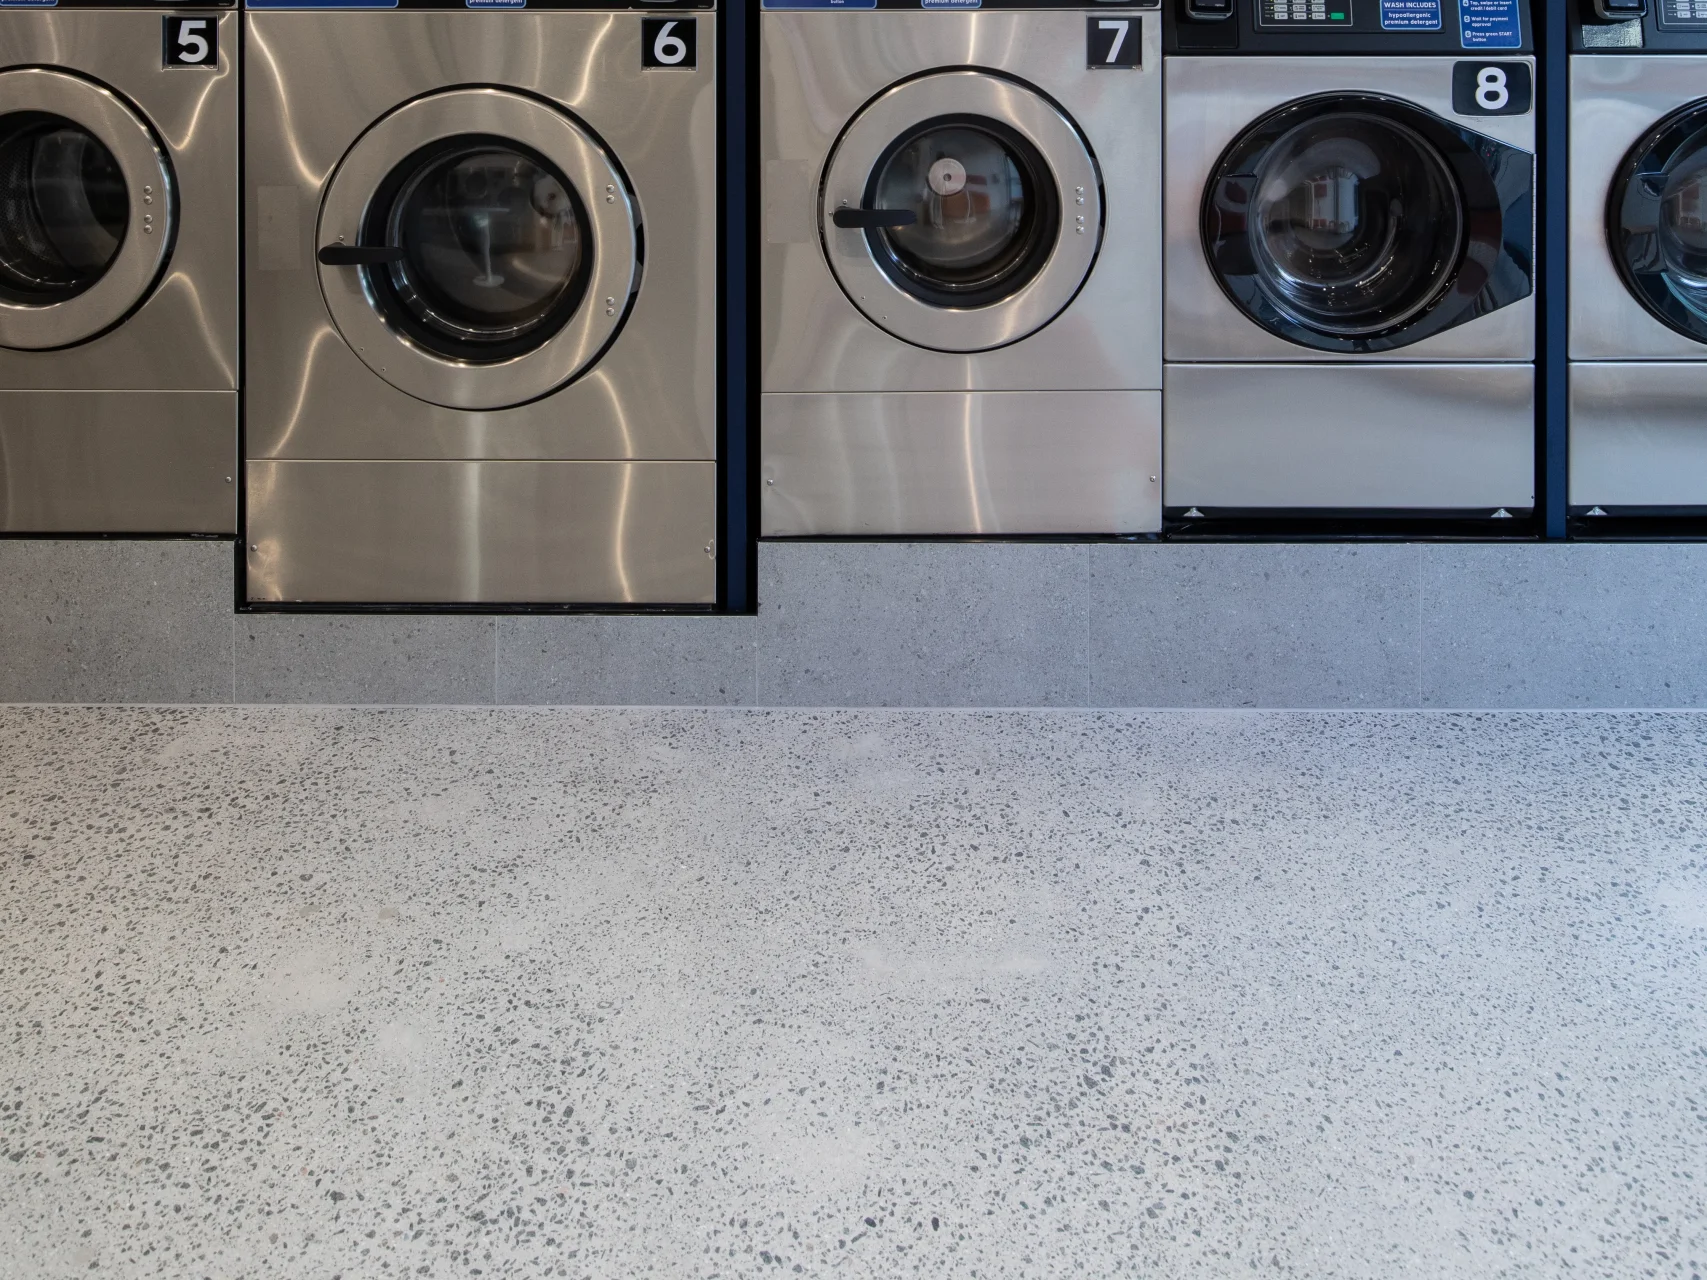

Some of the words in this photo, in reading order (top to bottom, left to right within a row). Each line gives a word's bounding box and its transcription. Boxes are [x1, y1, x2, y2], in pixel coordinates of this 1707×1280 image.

[1384, 1, 1405, 9] WASH
[1405, 1, 1437, 9] INCLUDES
[177, 20, 209, 63] 5
[653, 21, 687, 64] 6
[1098, 20, 1129, 62] 7
[1475, 66, 1509, 110] 8
